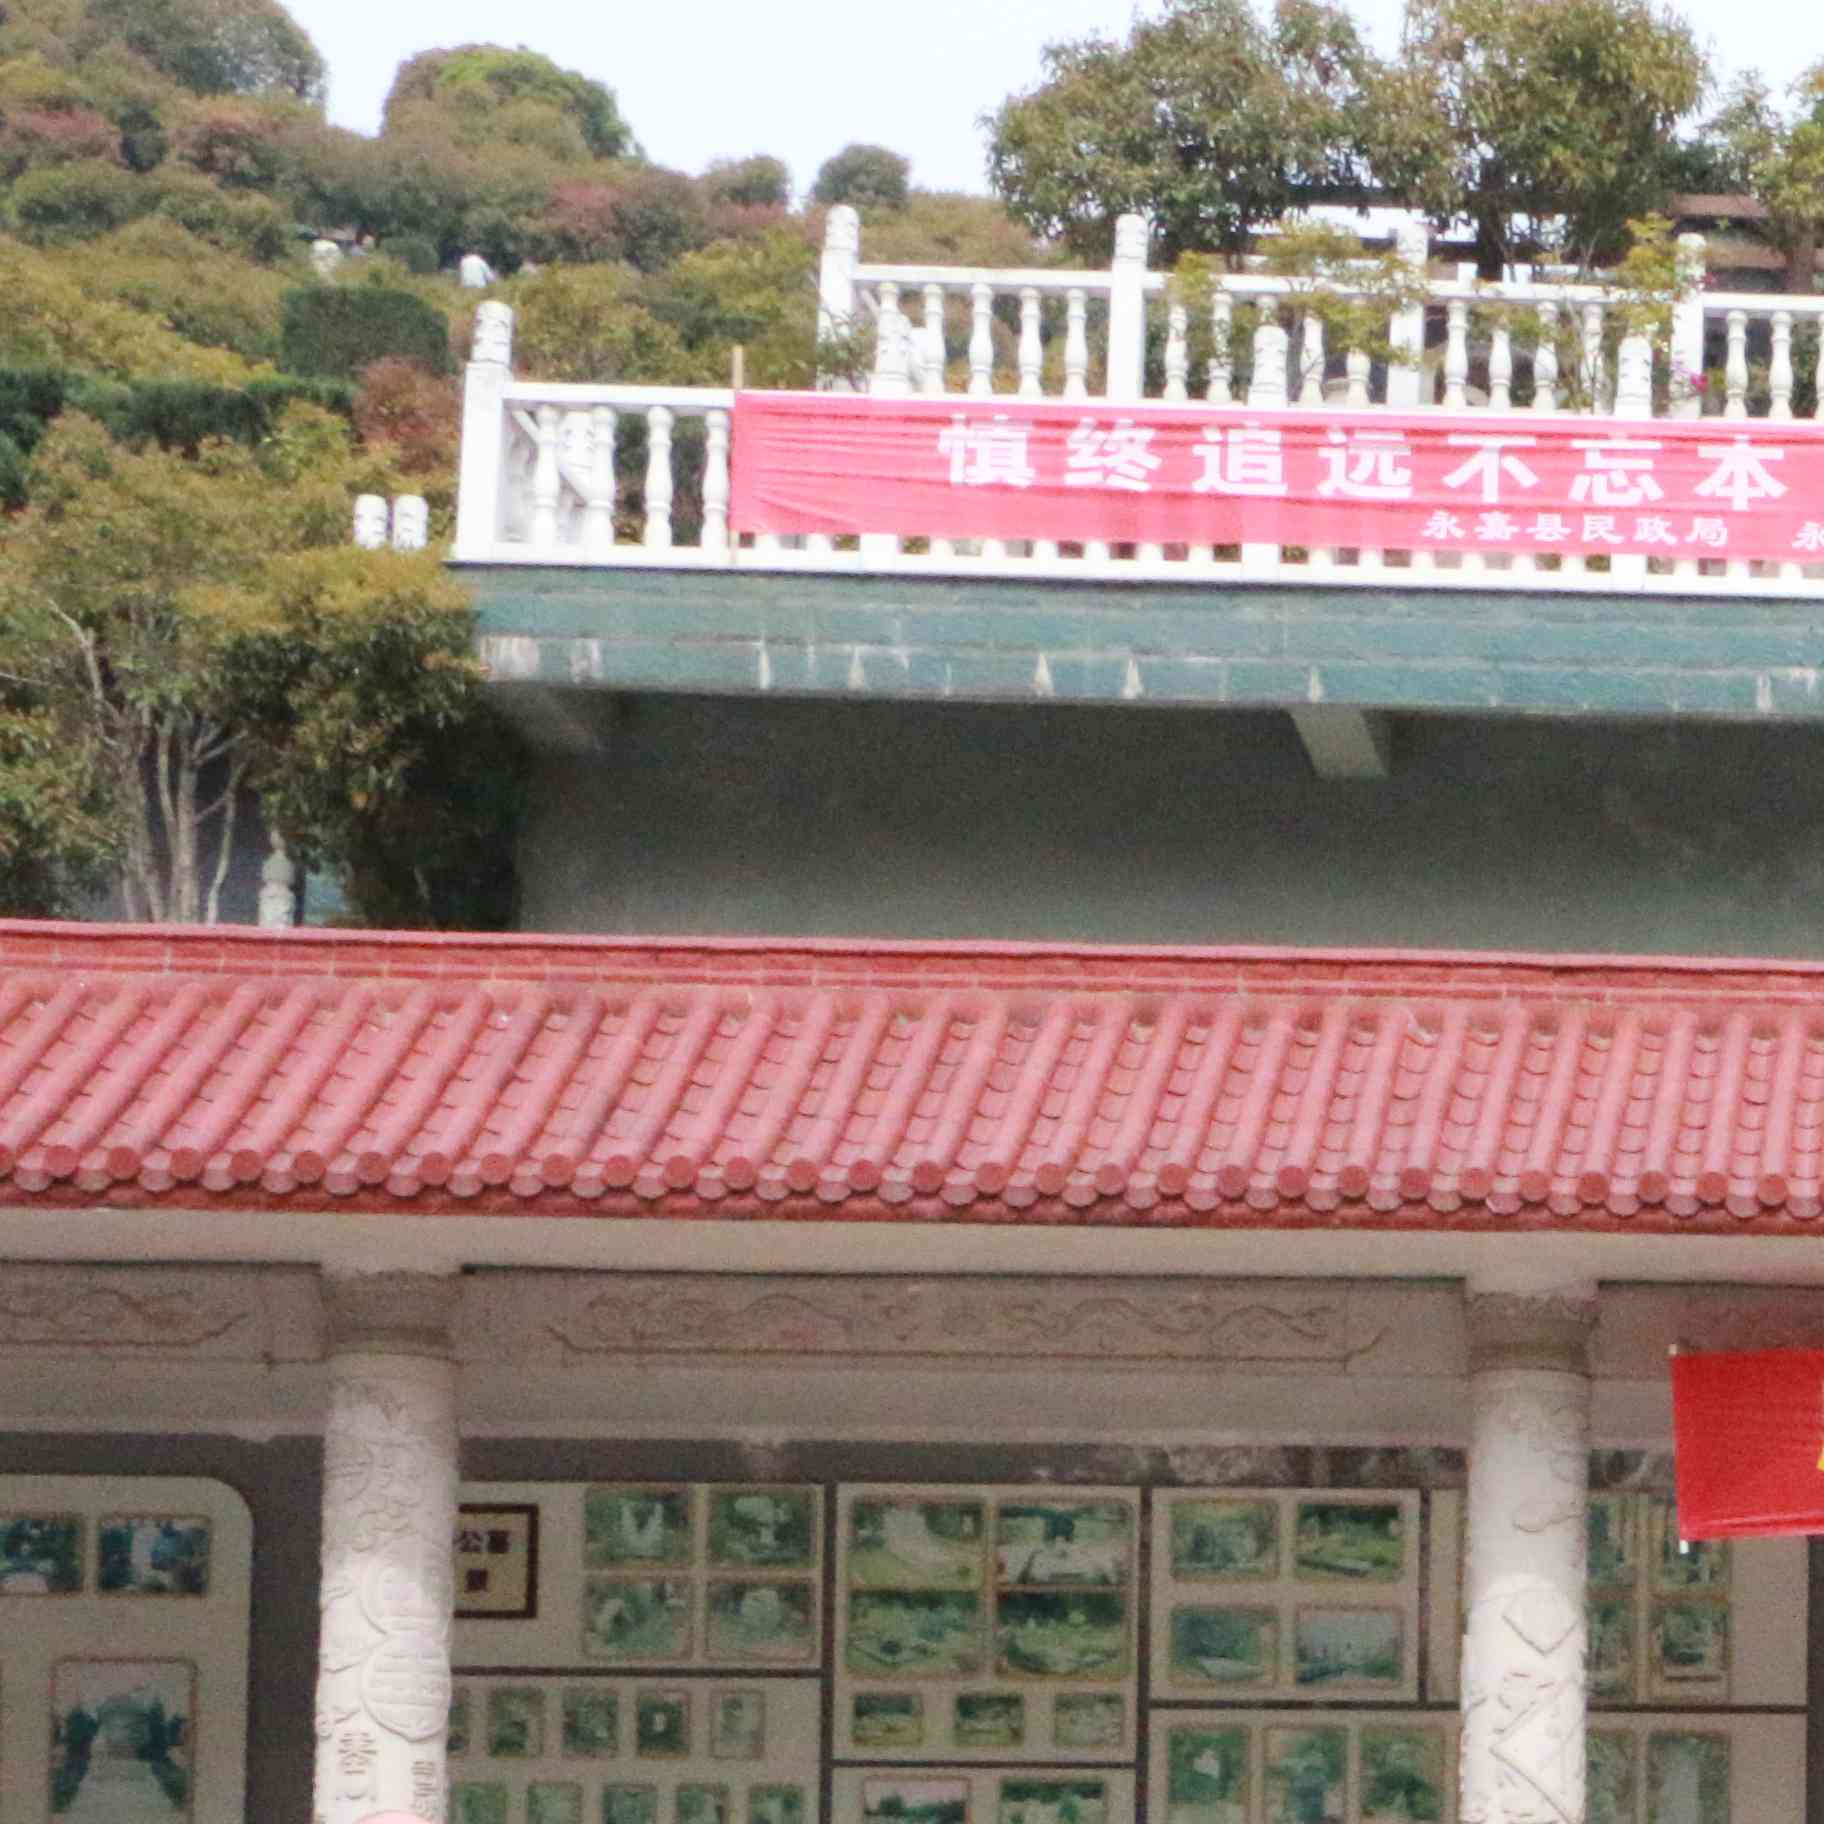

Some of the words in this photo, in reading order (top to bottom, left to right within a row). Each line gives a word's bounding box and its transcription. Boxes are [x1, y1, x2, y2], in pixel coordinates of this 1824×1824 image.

[938, 413, 1788, 511] 慎终追远不忘本
[1421, 510, 1729, 547] 永嘉县民政局
